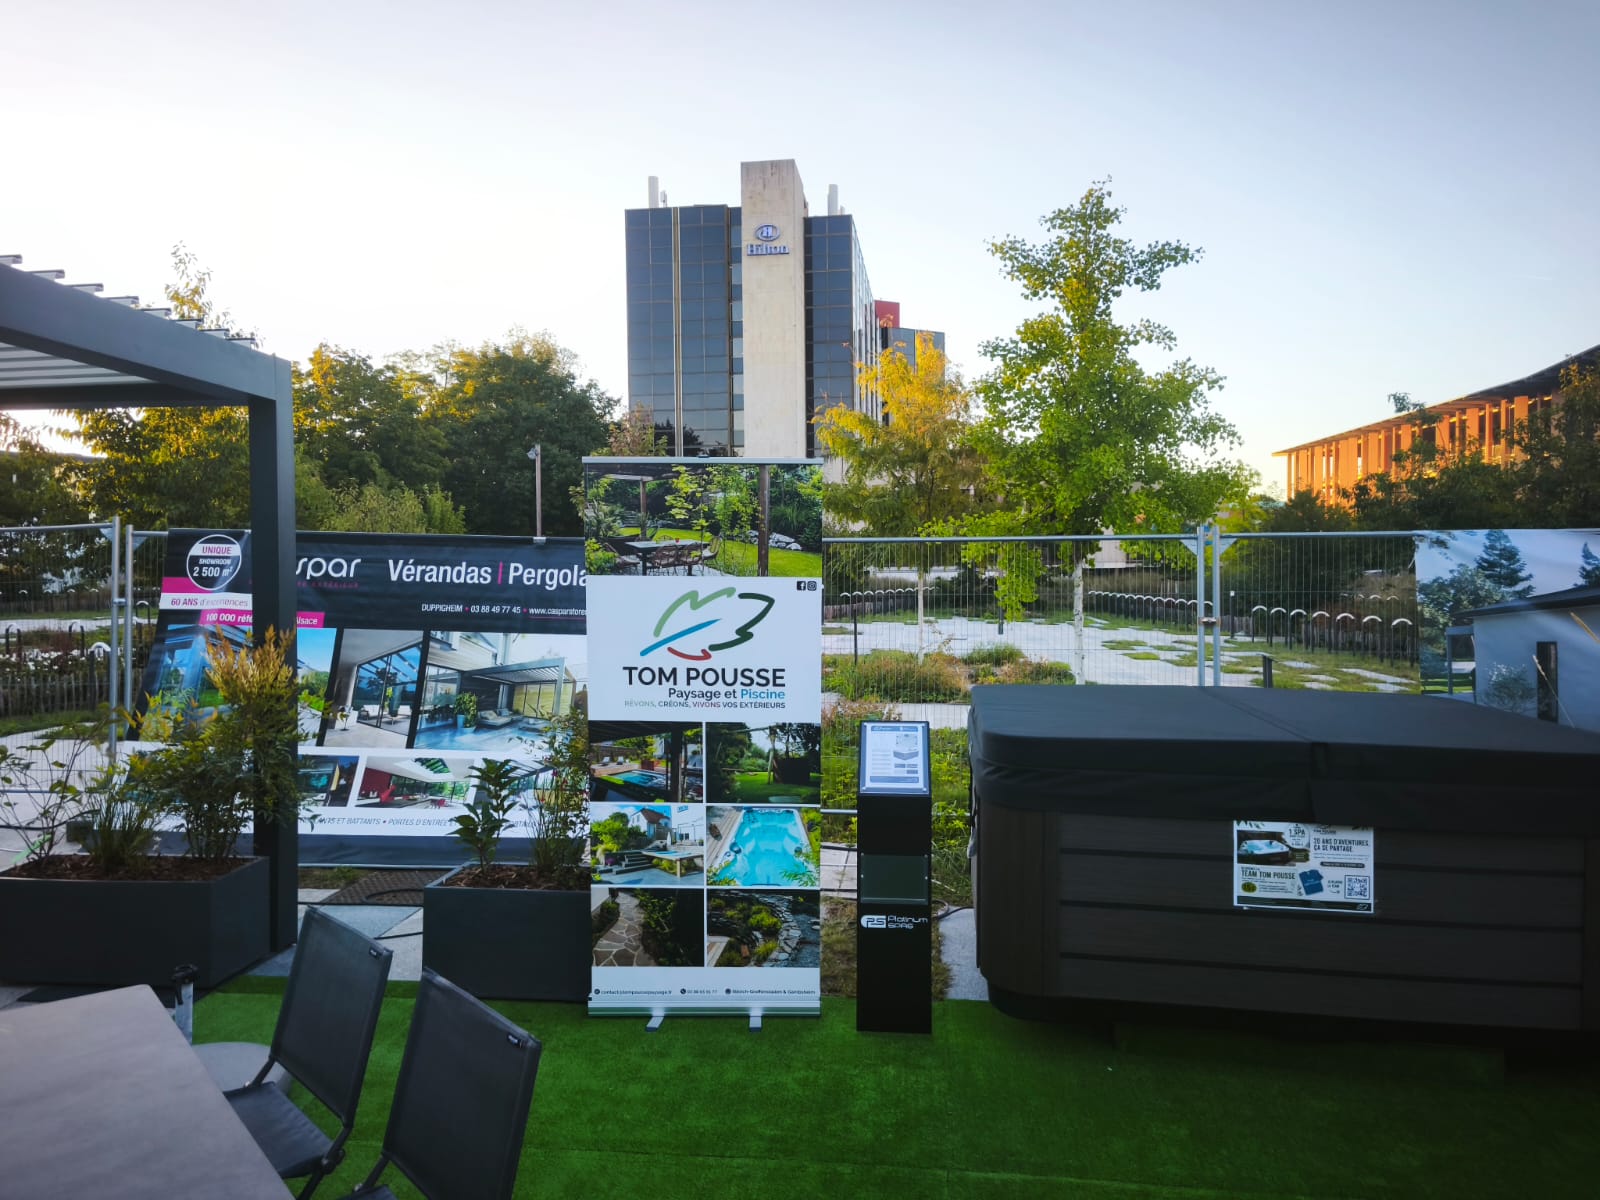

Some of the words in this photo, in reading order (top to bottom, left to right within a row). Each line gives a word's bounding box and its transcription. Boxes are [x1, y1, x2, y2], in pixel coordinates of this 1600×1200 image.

[747, 244, 790, 256] Hilton
[202, 546, 232, 555] UNIQUE
[193, 567, 199, 577] 2
[201, 567, 220, 577] 500
[296, 557, 362, 580] spar
[388, 559, 492, 584] Vérandas
[508, 562, 586, 591] Pergola
[171, 598, 181, 606] 60
[182, 598, 198, 606] ANS
[421, 603, 463, 613] DUPPIGHEIM
[470, 605, 480, 613] 03
[481, 605, 490, 613] 88
[491, 606, 501, 614] 49
[501, 606, 511, 614] 77
[511, 606, 521, 614] 45
[206, 612, 218, 622] 100
[219, 613, 236, 622] 000
[622, 666, 678, 686] TOM
[686, 666, 786, 688] POUSSE
[668, 688, 721, 701] Paysage
[724, 688, 737, 699] et
[740, 688, 785, 700] Piscine
[722, 701, 738, 709] VOS
[739, 700, 786, 709] EXTÉRIEURS
